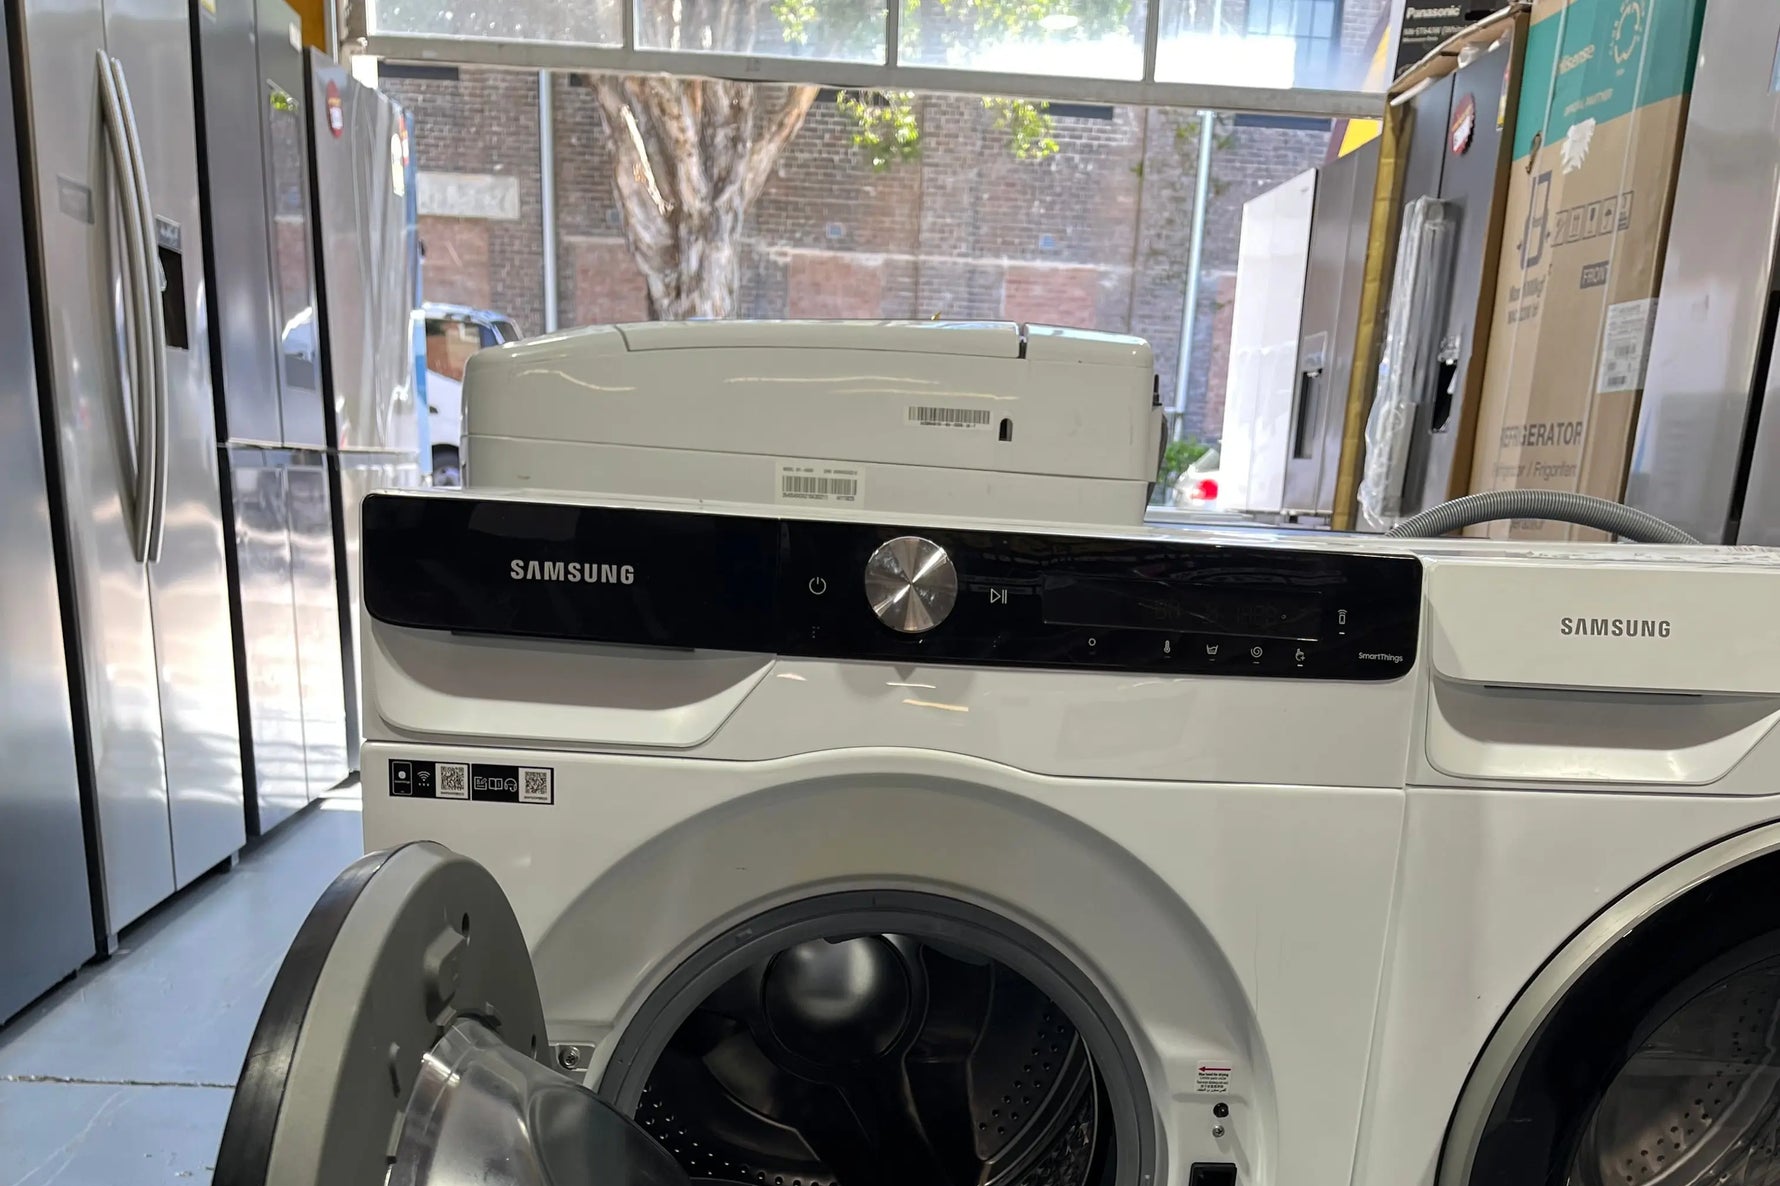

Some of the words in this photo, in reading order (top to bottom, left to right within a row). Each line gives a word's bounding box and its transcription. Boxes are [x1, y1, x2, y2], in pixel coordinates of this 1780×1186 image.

[1406, 5, 1461, 19] Panasonic
[510, 559, 635, 585] SAMSUNG
[1560, 617, 1671, 638] SAMSUNG
[1358, 652, 1403, 663] SmartThings
